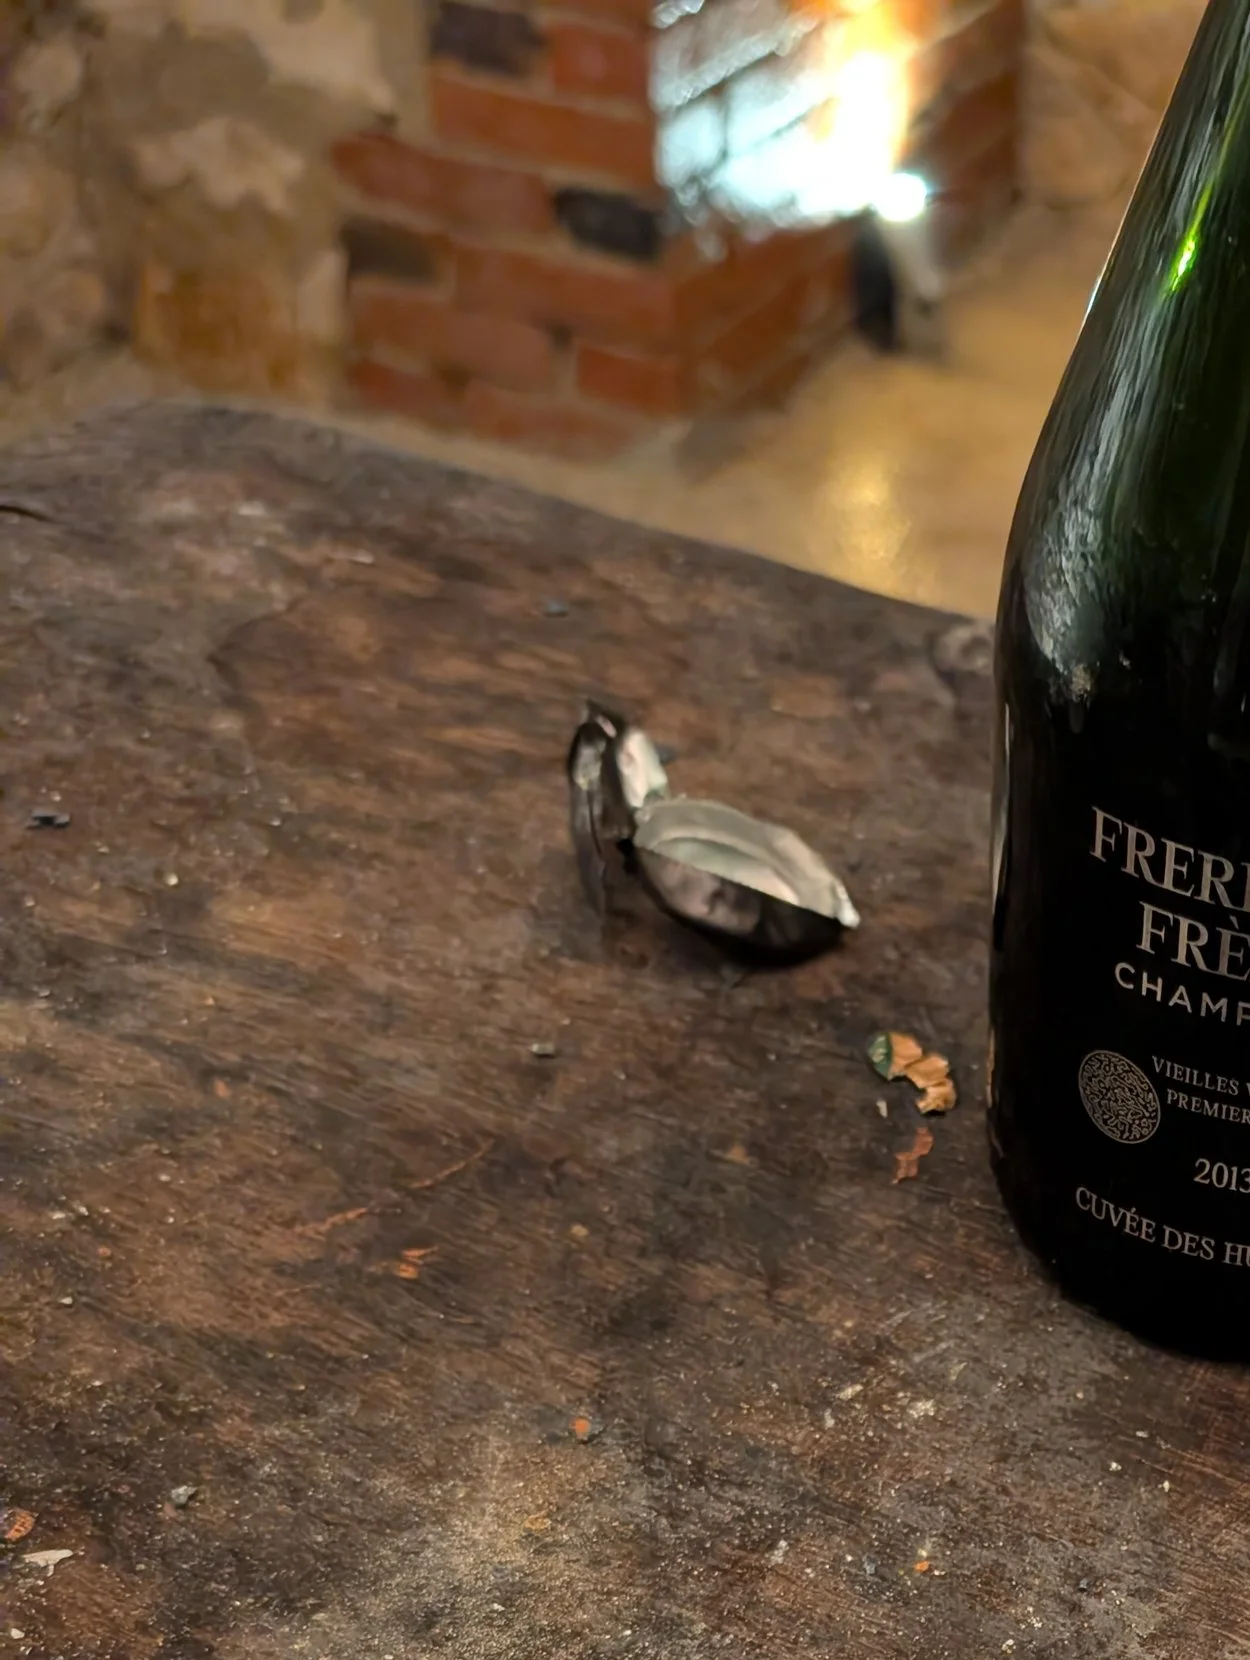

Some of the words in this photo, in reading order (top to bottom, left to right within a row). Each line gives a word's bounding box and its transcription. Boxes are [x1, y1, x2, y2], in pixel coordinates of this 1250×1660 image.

[1152, 1055, 1239, 1097] VIEILLES
[1075, 1187, 1156, 1243] CUVÉE
[1162, 1226, 1216, 1262] DES
